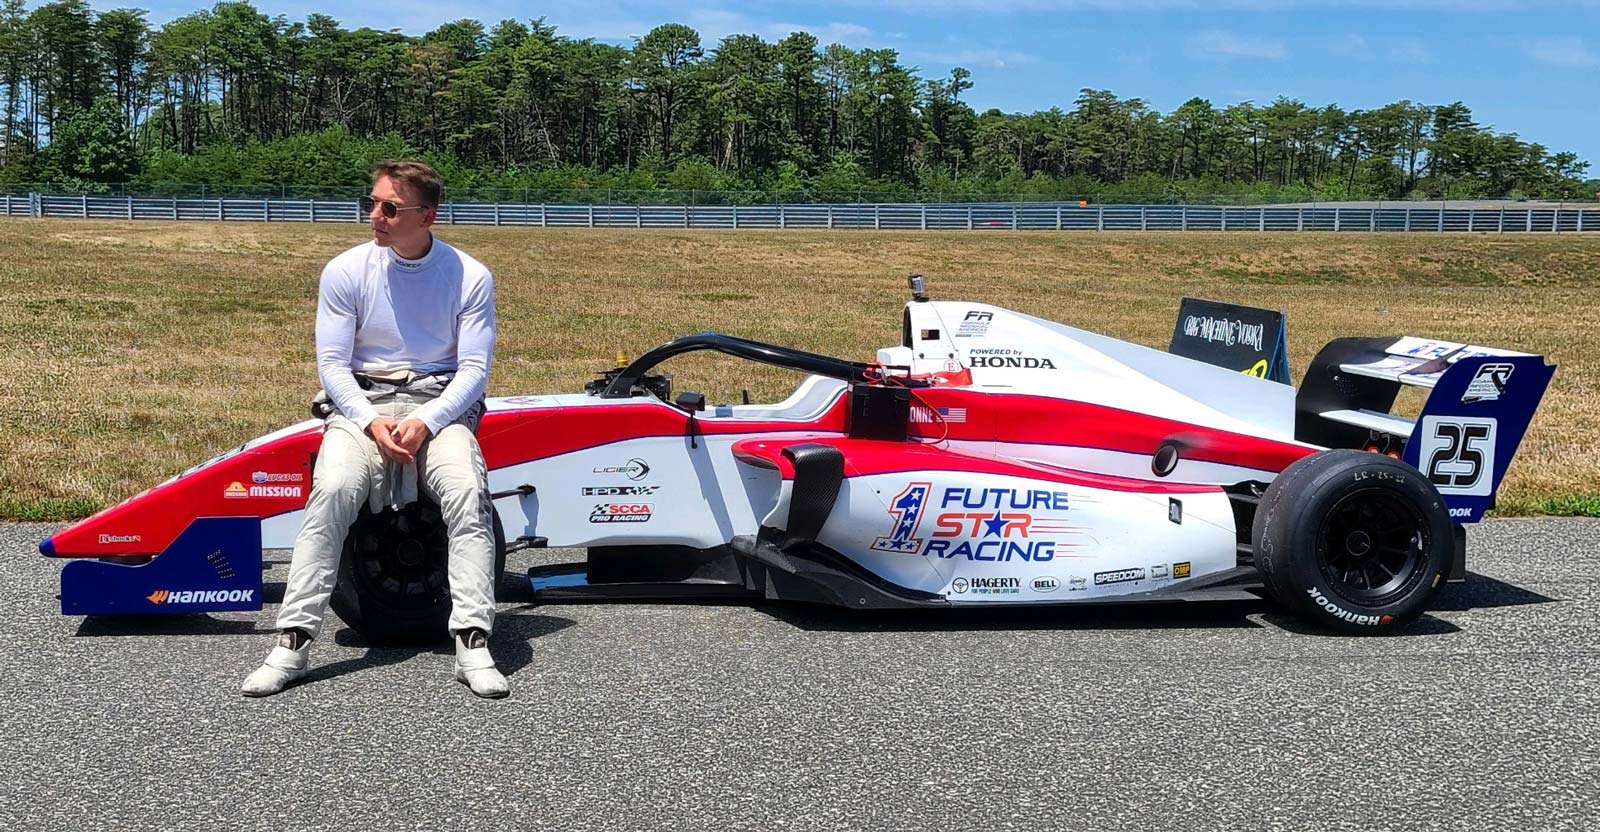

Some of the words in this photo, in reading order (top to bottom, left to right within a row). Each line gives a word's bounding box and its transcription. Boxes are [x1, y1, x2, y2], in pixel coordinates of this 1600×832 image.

[964, 311, 994, 321] FR
[1184, 315, 1199, 336] BIG
[1199, 316, 1236, 346] MACHINE
[1235, 320, 1263, 351] VODKA
[948, 362, 955, 371] E
[969, 356, 1057, 369] HONDA
[910, 406, 934, 423] ONNE
[1427, 422, 1491, 489] 25
[592, 466, 639, 474] LIGIER
[268, 473, 290, 482] LUCAS
[291, 473, 303, 481] OIL
[250, 485, 301, 497] MISSION
[583, 487, 621, 496] HPD
[941, 487, 1069, 511] FUTURE
[609, 504, 651, 514] SCCA
[591, 514, 611, 522] PRO
[922, 540, 1055, 562] RACING
[1174, 564, 1189, 576] OMP
[1095, 568, 1145, 584] SPEEDCOM
[971, 577, 1020, 588] HAGERTY
[1034, 580, 1057, 588] BELL
